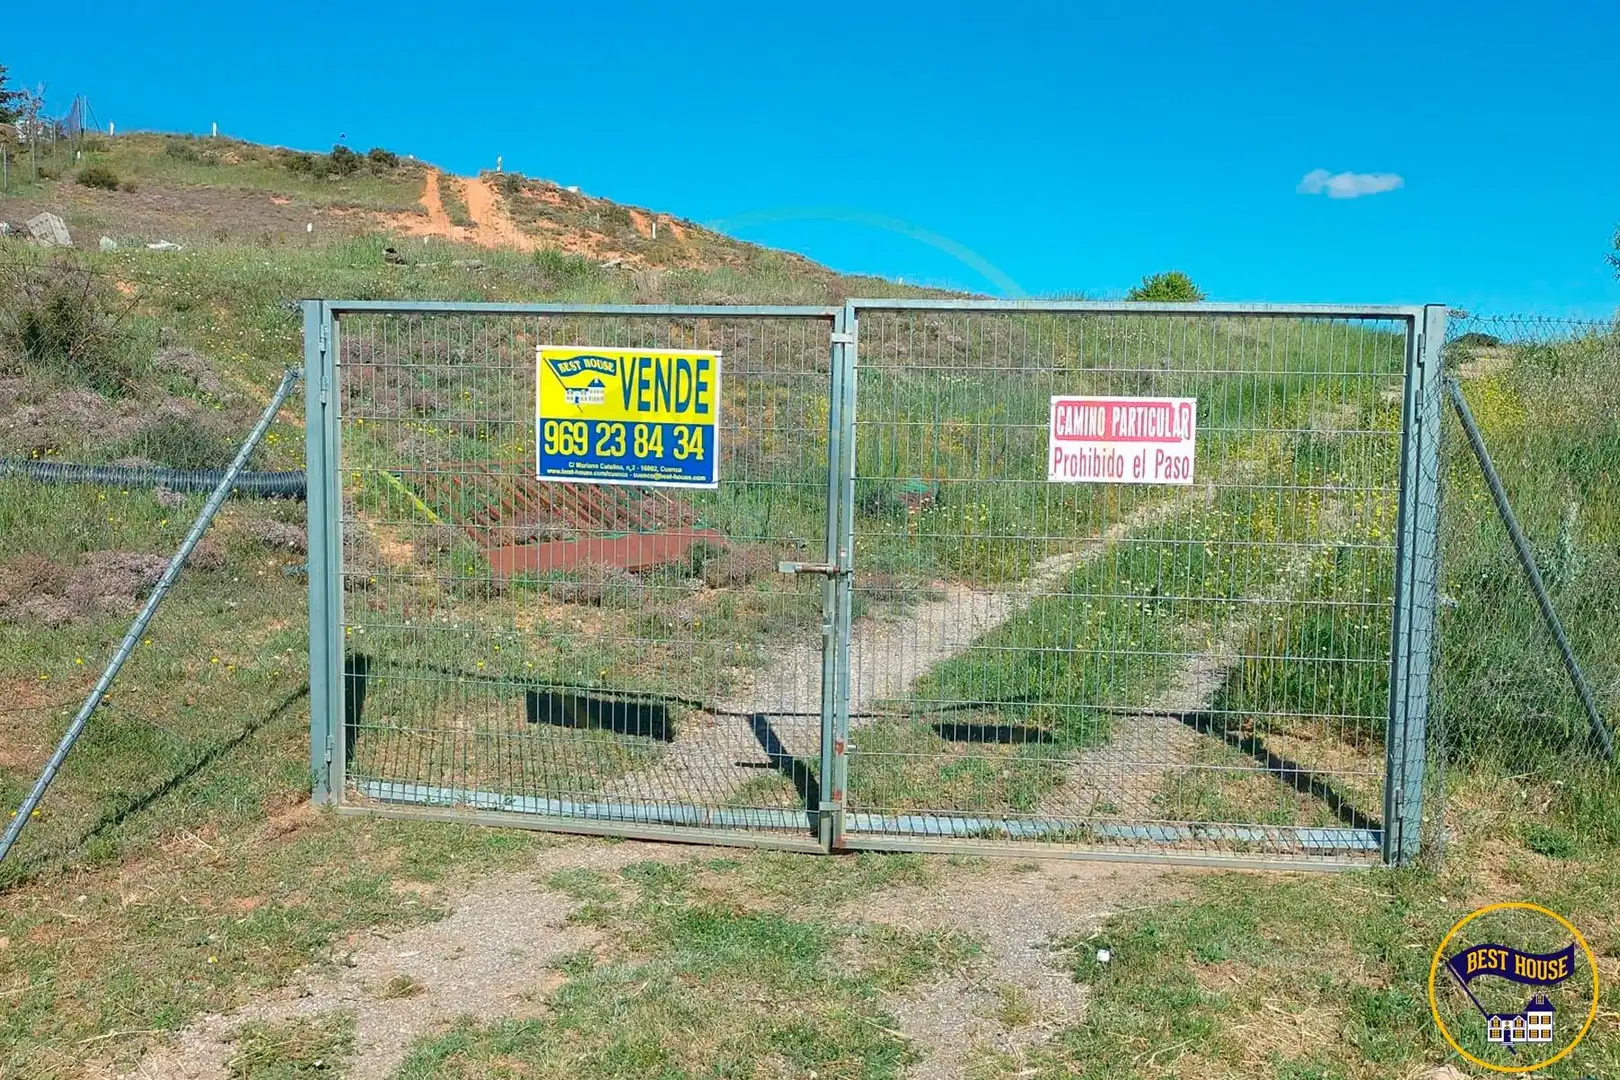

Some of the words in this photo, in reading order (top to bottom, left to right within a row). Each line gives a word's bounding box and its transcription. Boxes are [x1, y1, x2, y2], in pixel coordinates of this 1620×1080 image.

[557, 360, 582, 373] BEST
[583, 358, 615, 373] HOUSE
[619, 357, 710, 414] VENDE
[544, 420, 588, 456] 969
[595, 422, 626, 457] 23
[634, 424, 663, 458] 84
[673, 425, 704, 460] 34
[1056, 405, 1106, 439] CAMINO
[1112, 405, 1191, 440] PARTICULAR
[1054, 447, 1124, 478] Prohibido
[1133, 448, 1146, 479] el
[1155, 449, 1190, 480] Paso
